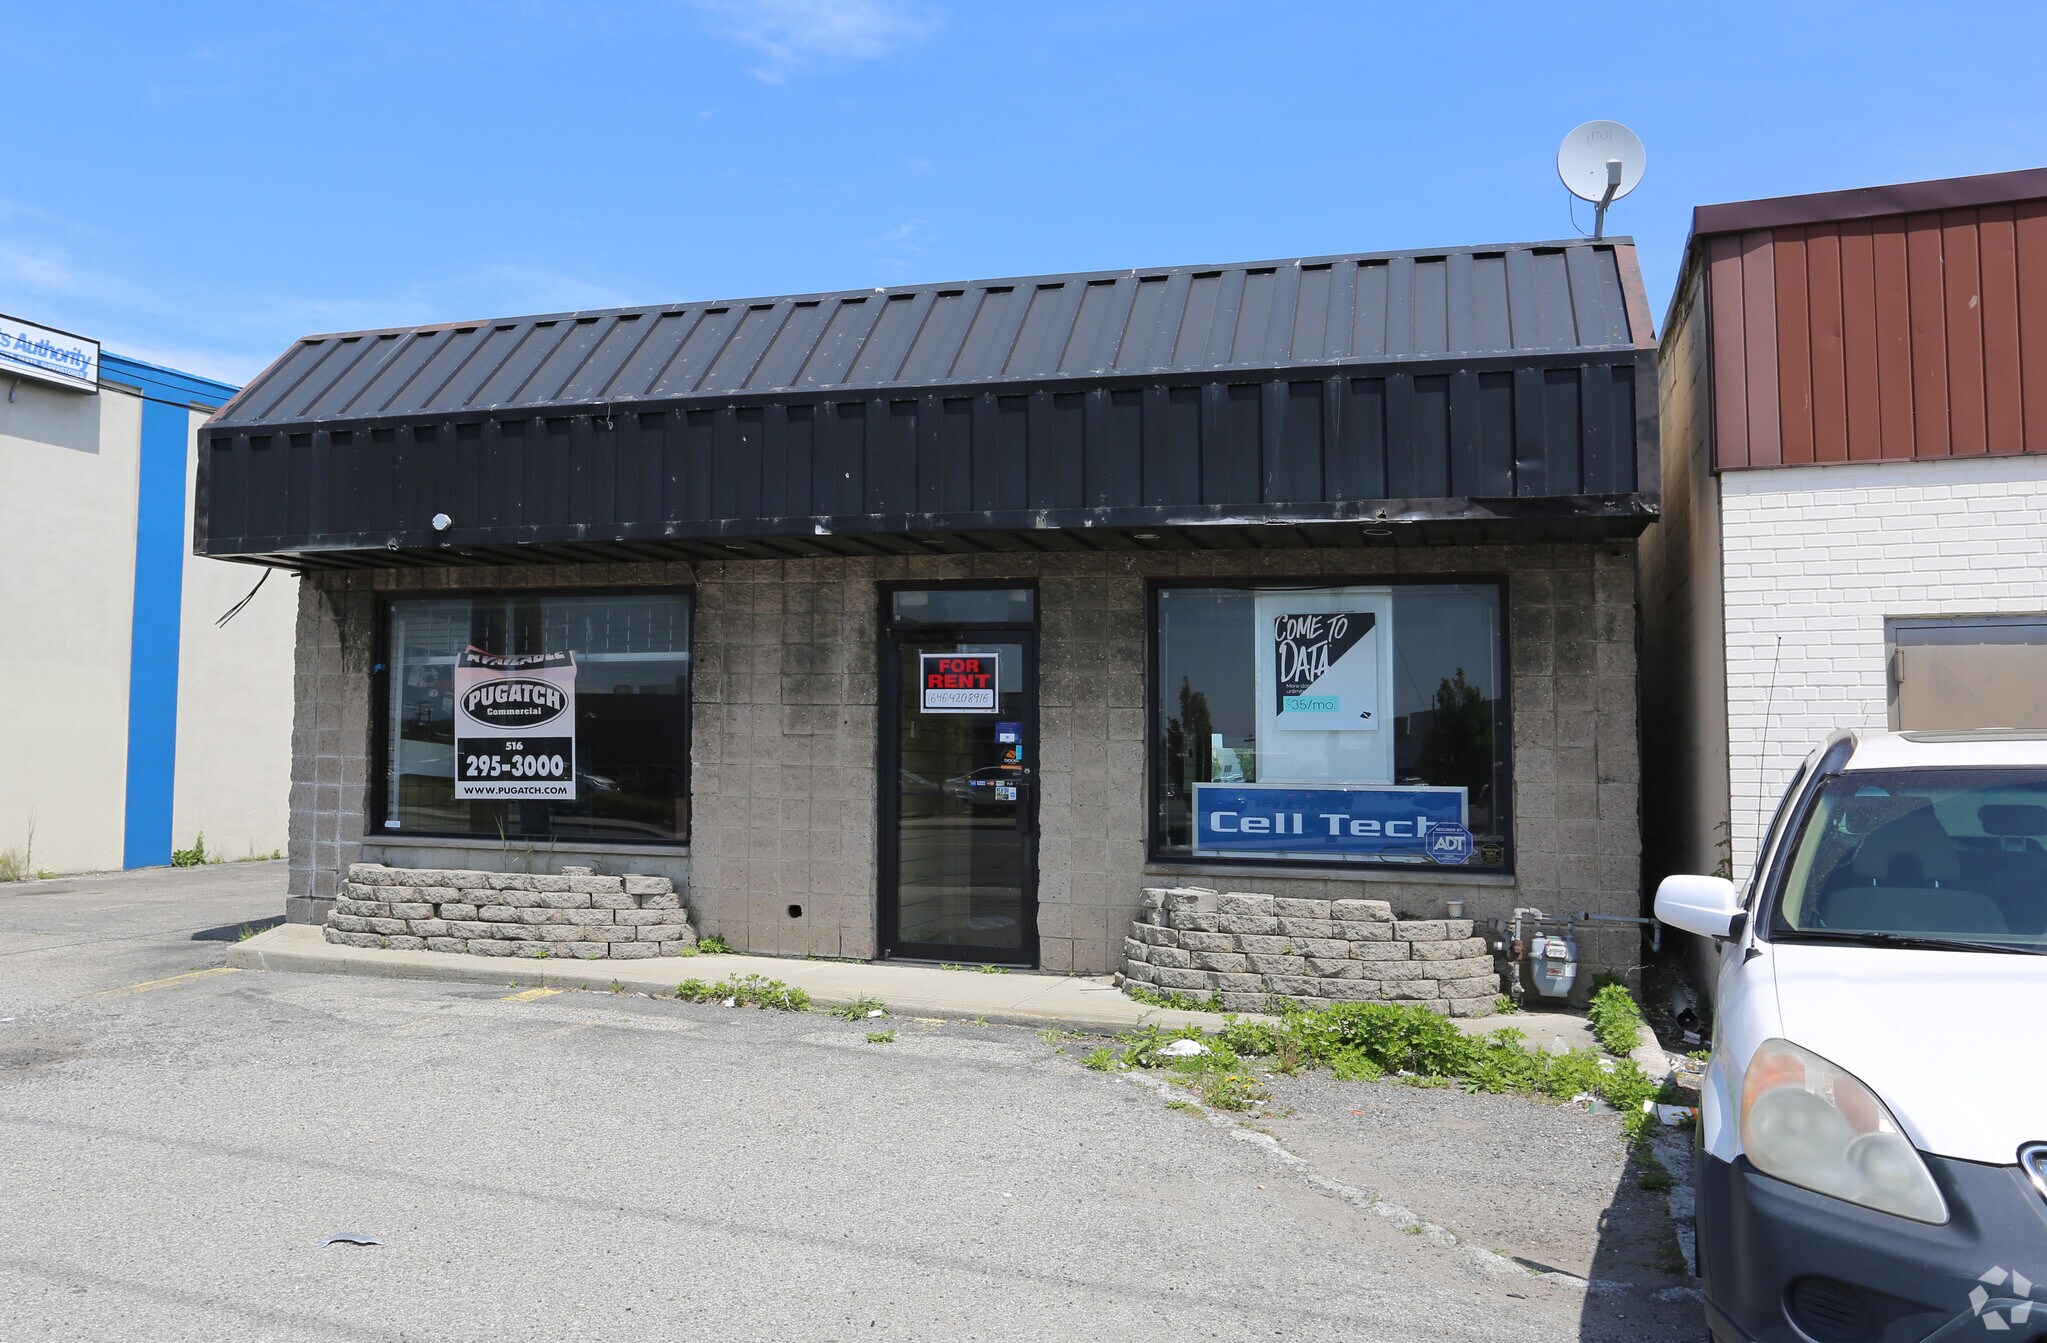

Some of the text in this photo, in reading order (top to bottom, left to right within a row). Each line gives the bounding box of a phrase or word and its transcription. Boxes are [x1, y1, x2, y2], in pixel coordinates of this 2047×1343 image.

[13, 333, 92, 370] Authority
[1274, 614, 1348, 642] COME TO
[939, 659, 980, 673] FOR
[1279, 640, 1331, 682] DATA
[928, 674, 991, 688] RENT
[468, 684, 561, 711] PUGATCH
[1287, 699, 1336, 710] $35/mo.
[487, 707, 542, 715] Commercial
[505, 741, 524, 751] 516
[466, 754, 564, 777] 295-3000
[464, 786, 568, 795] WWW.PUGATCH.COM
[1210, 811, 1304, 835] Cell
[1433, 836, 1466, 851] ADT
